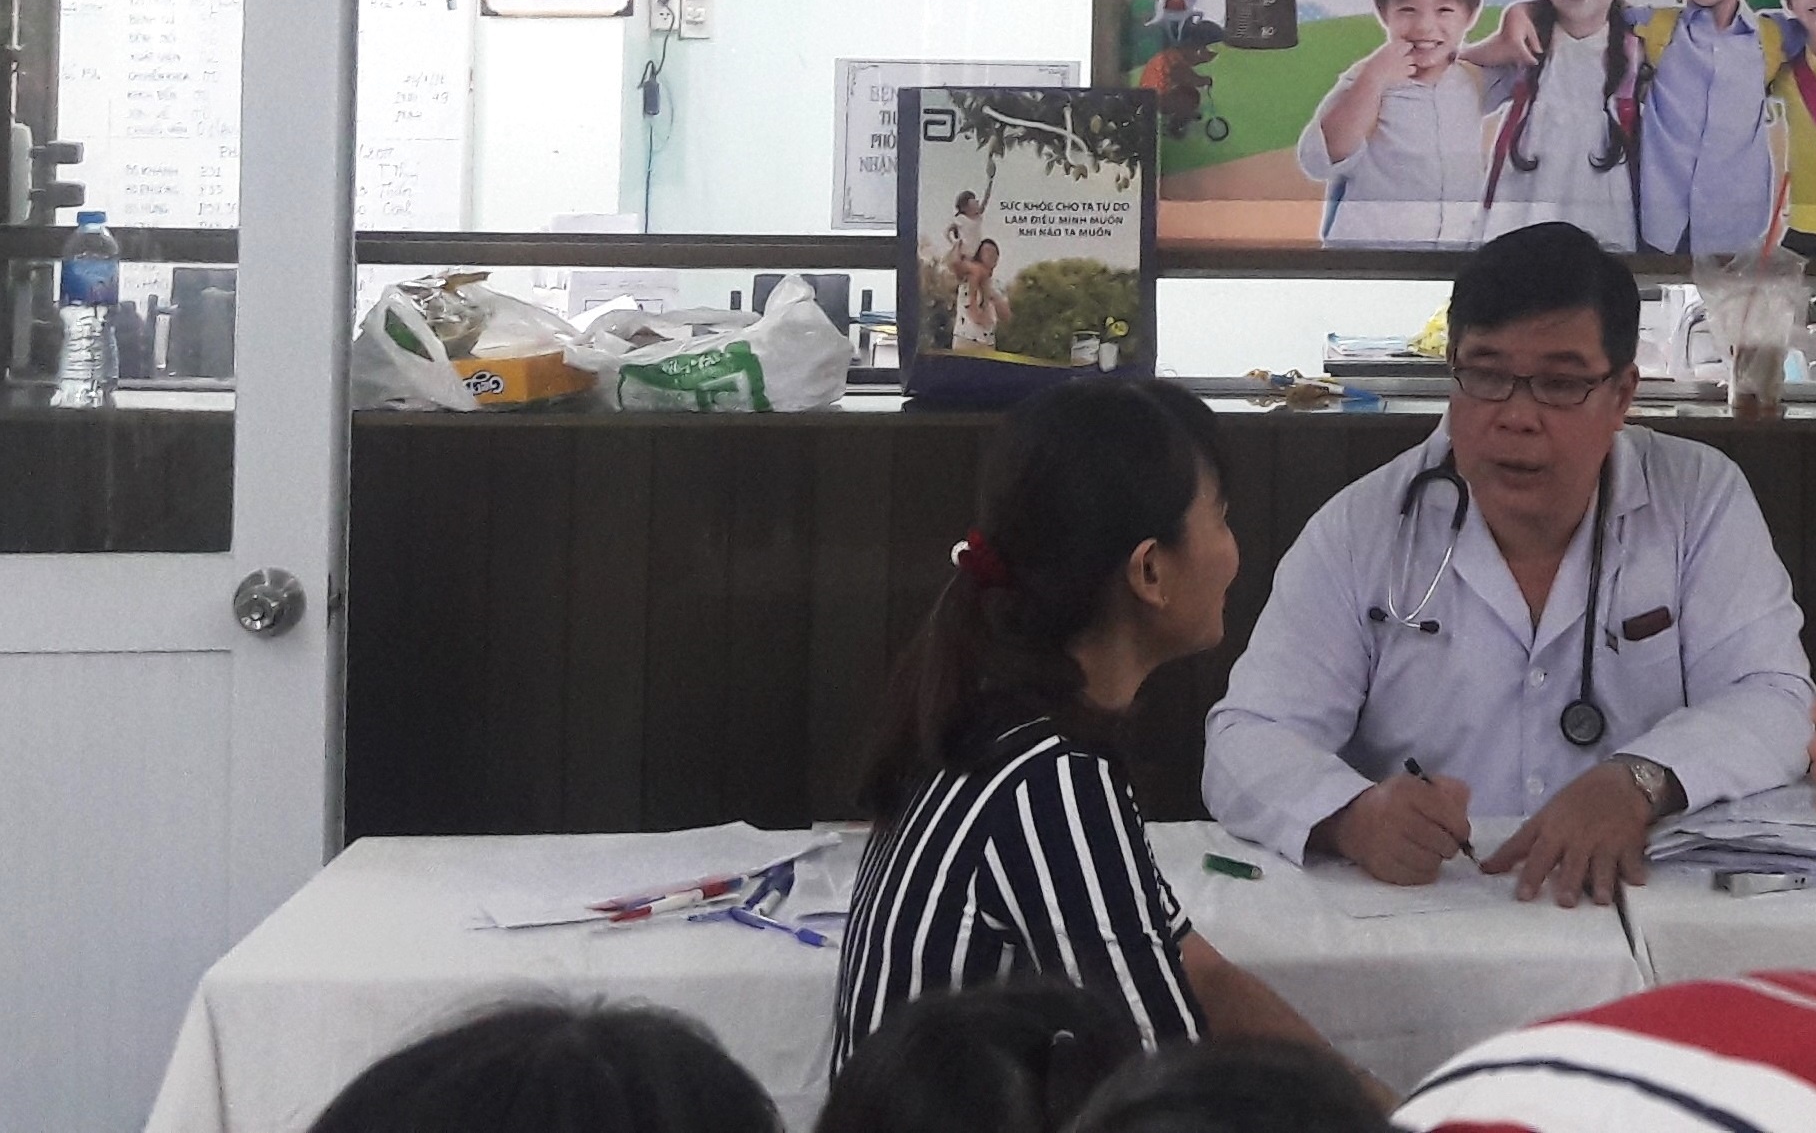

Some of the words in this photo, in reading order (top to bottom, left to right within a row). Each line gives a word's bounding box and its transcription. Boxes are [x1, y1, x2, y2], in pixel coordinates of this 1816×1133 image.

[1055, 201, 1080, 211] CHO
[1082, 202, 1095, 211] TA
[1113, 202, 1130, 211] DO
[1065, 228, 1076, 236] TA
